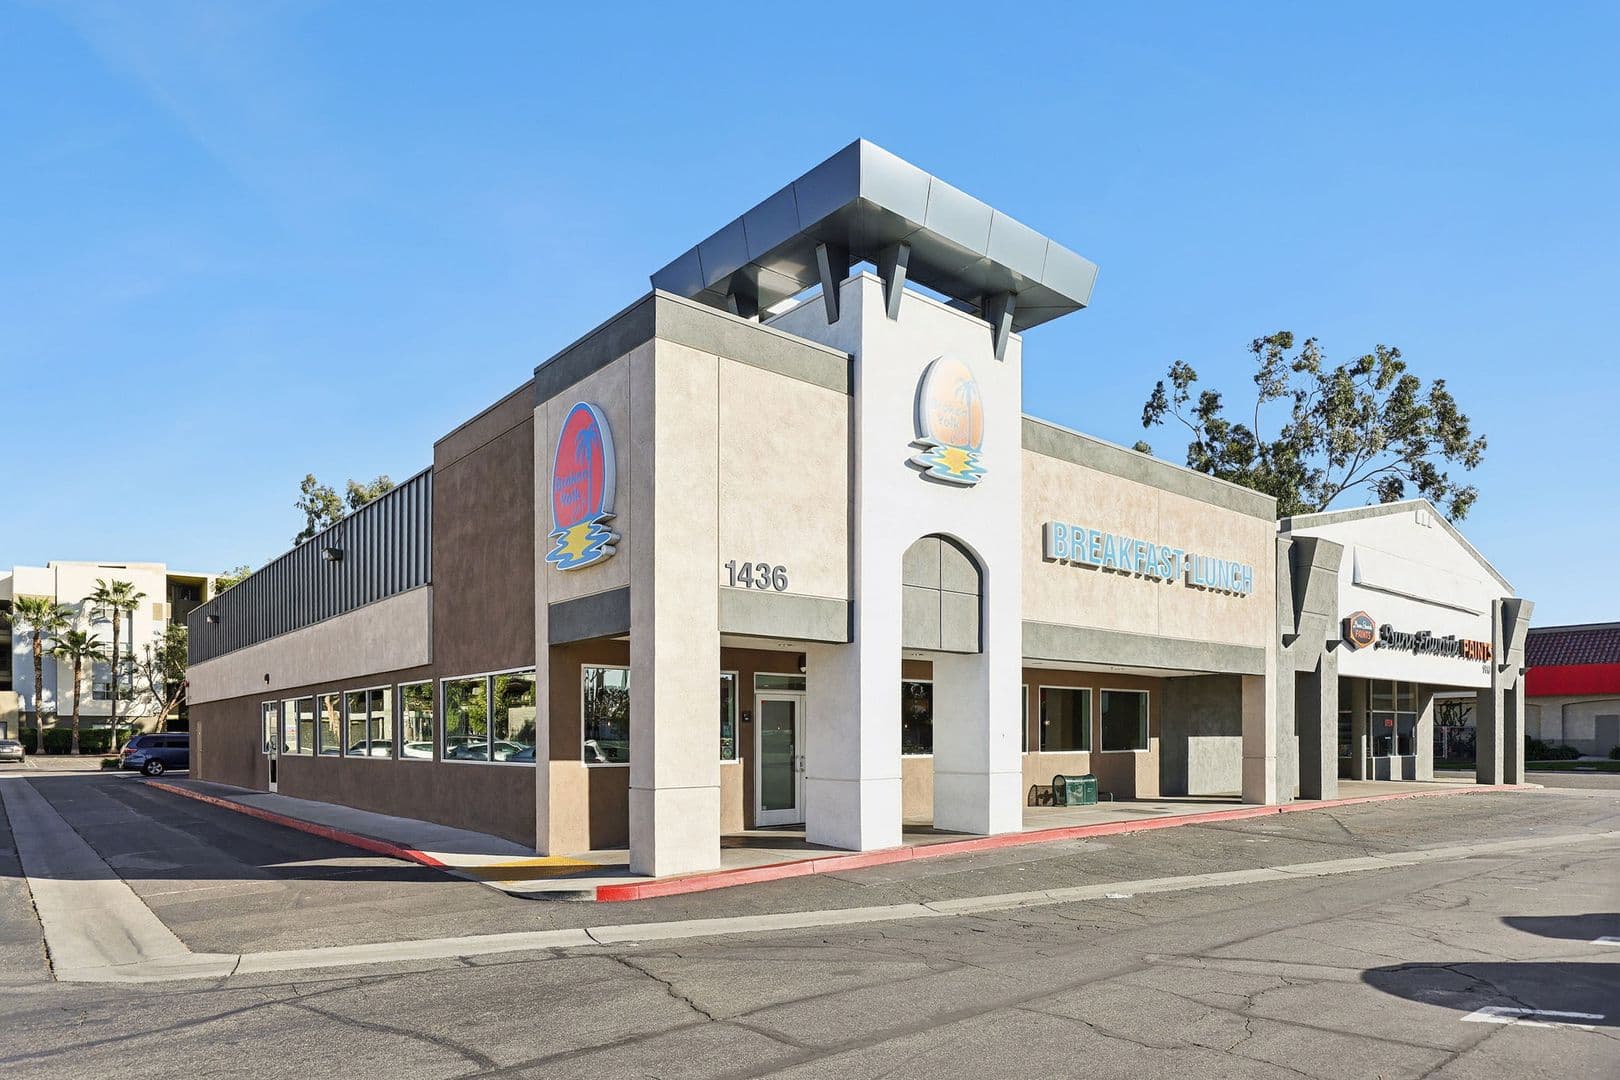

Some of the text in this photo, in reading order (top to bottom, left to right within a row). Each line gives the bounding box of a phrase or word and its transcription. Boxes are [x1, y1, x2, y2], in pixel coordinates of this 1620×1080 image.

[1050, 521, 1254, 594] BREAKFAST LUNCH
[724, 560, 788, 592] 1436
[1462, 639, 1493, 662] PAINTS
